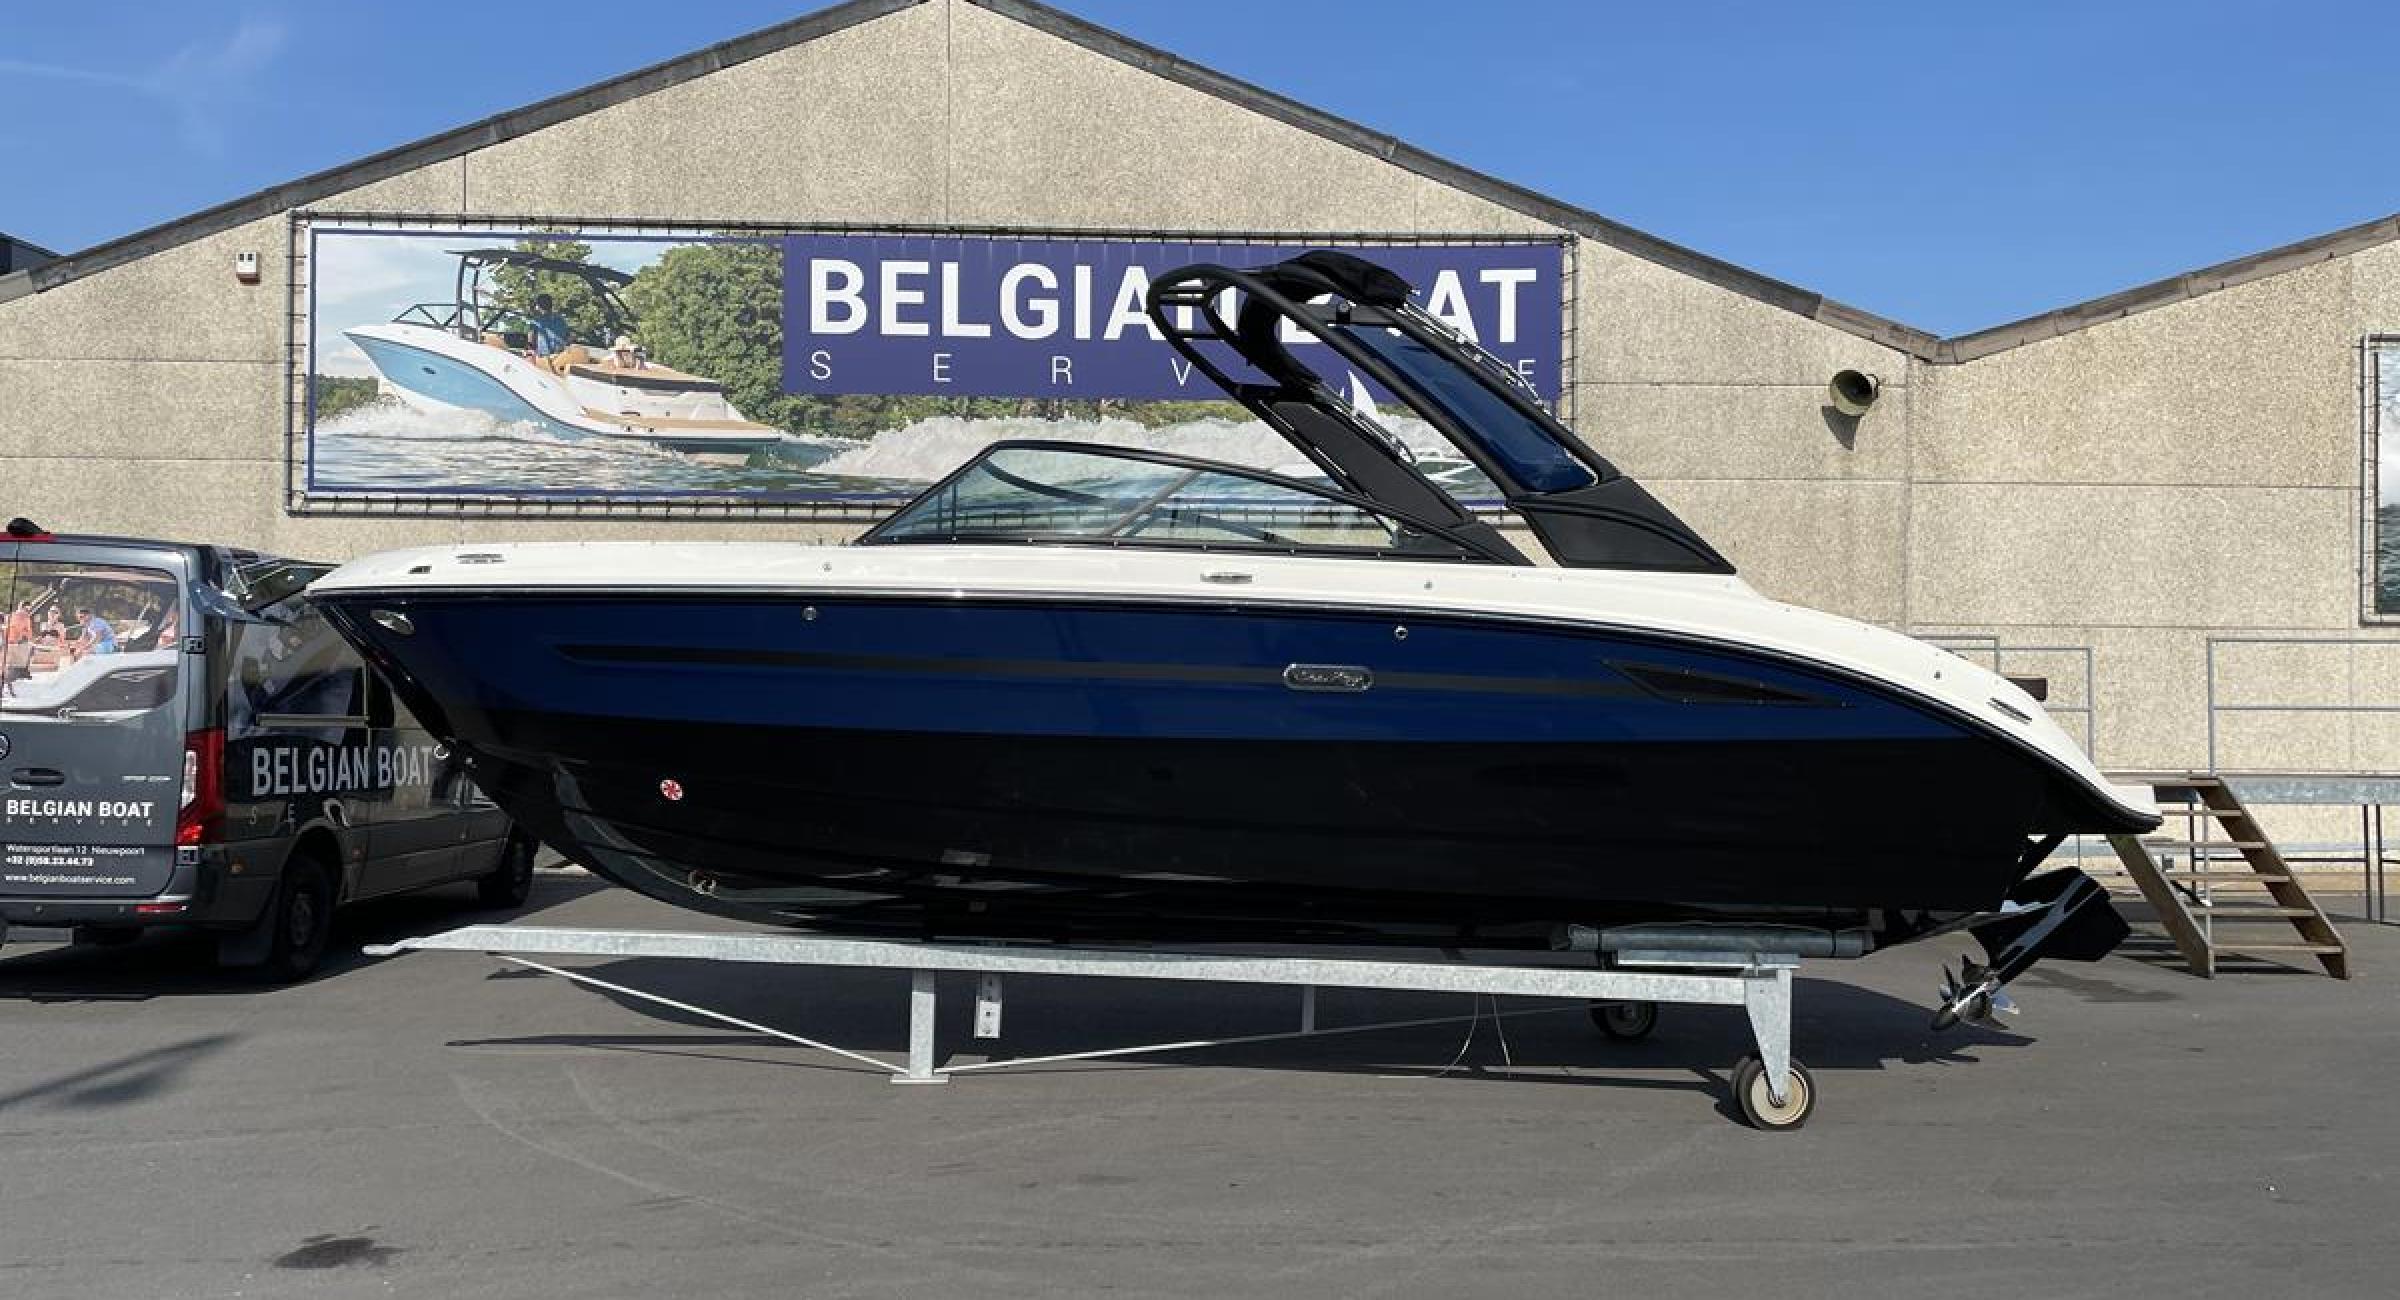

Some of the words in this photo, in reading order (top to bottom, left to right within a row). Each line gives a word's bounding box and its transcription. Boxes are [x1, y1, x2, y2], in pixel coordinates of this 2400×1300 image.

[1281, 267, 1537, 344] AT
[811, 350, 1537, 387] SERVE
[252, 746, 370, 796] BELGIAN
[377, 745, 433, 788] BOAT
[7, 800, 93, 817] BELGIAN
[99, 801, 154, 818] BOAT
